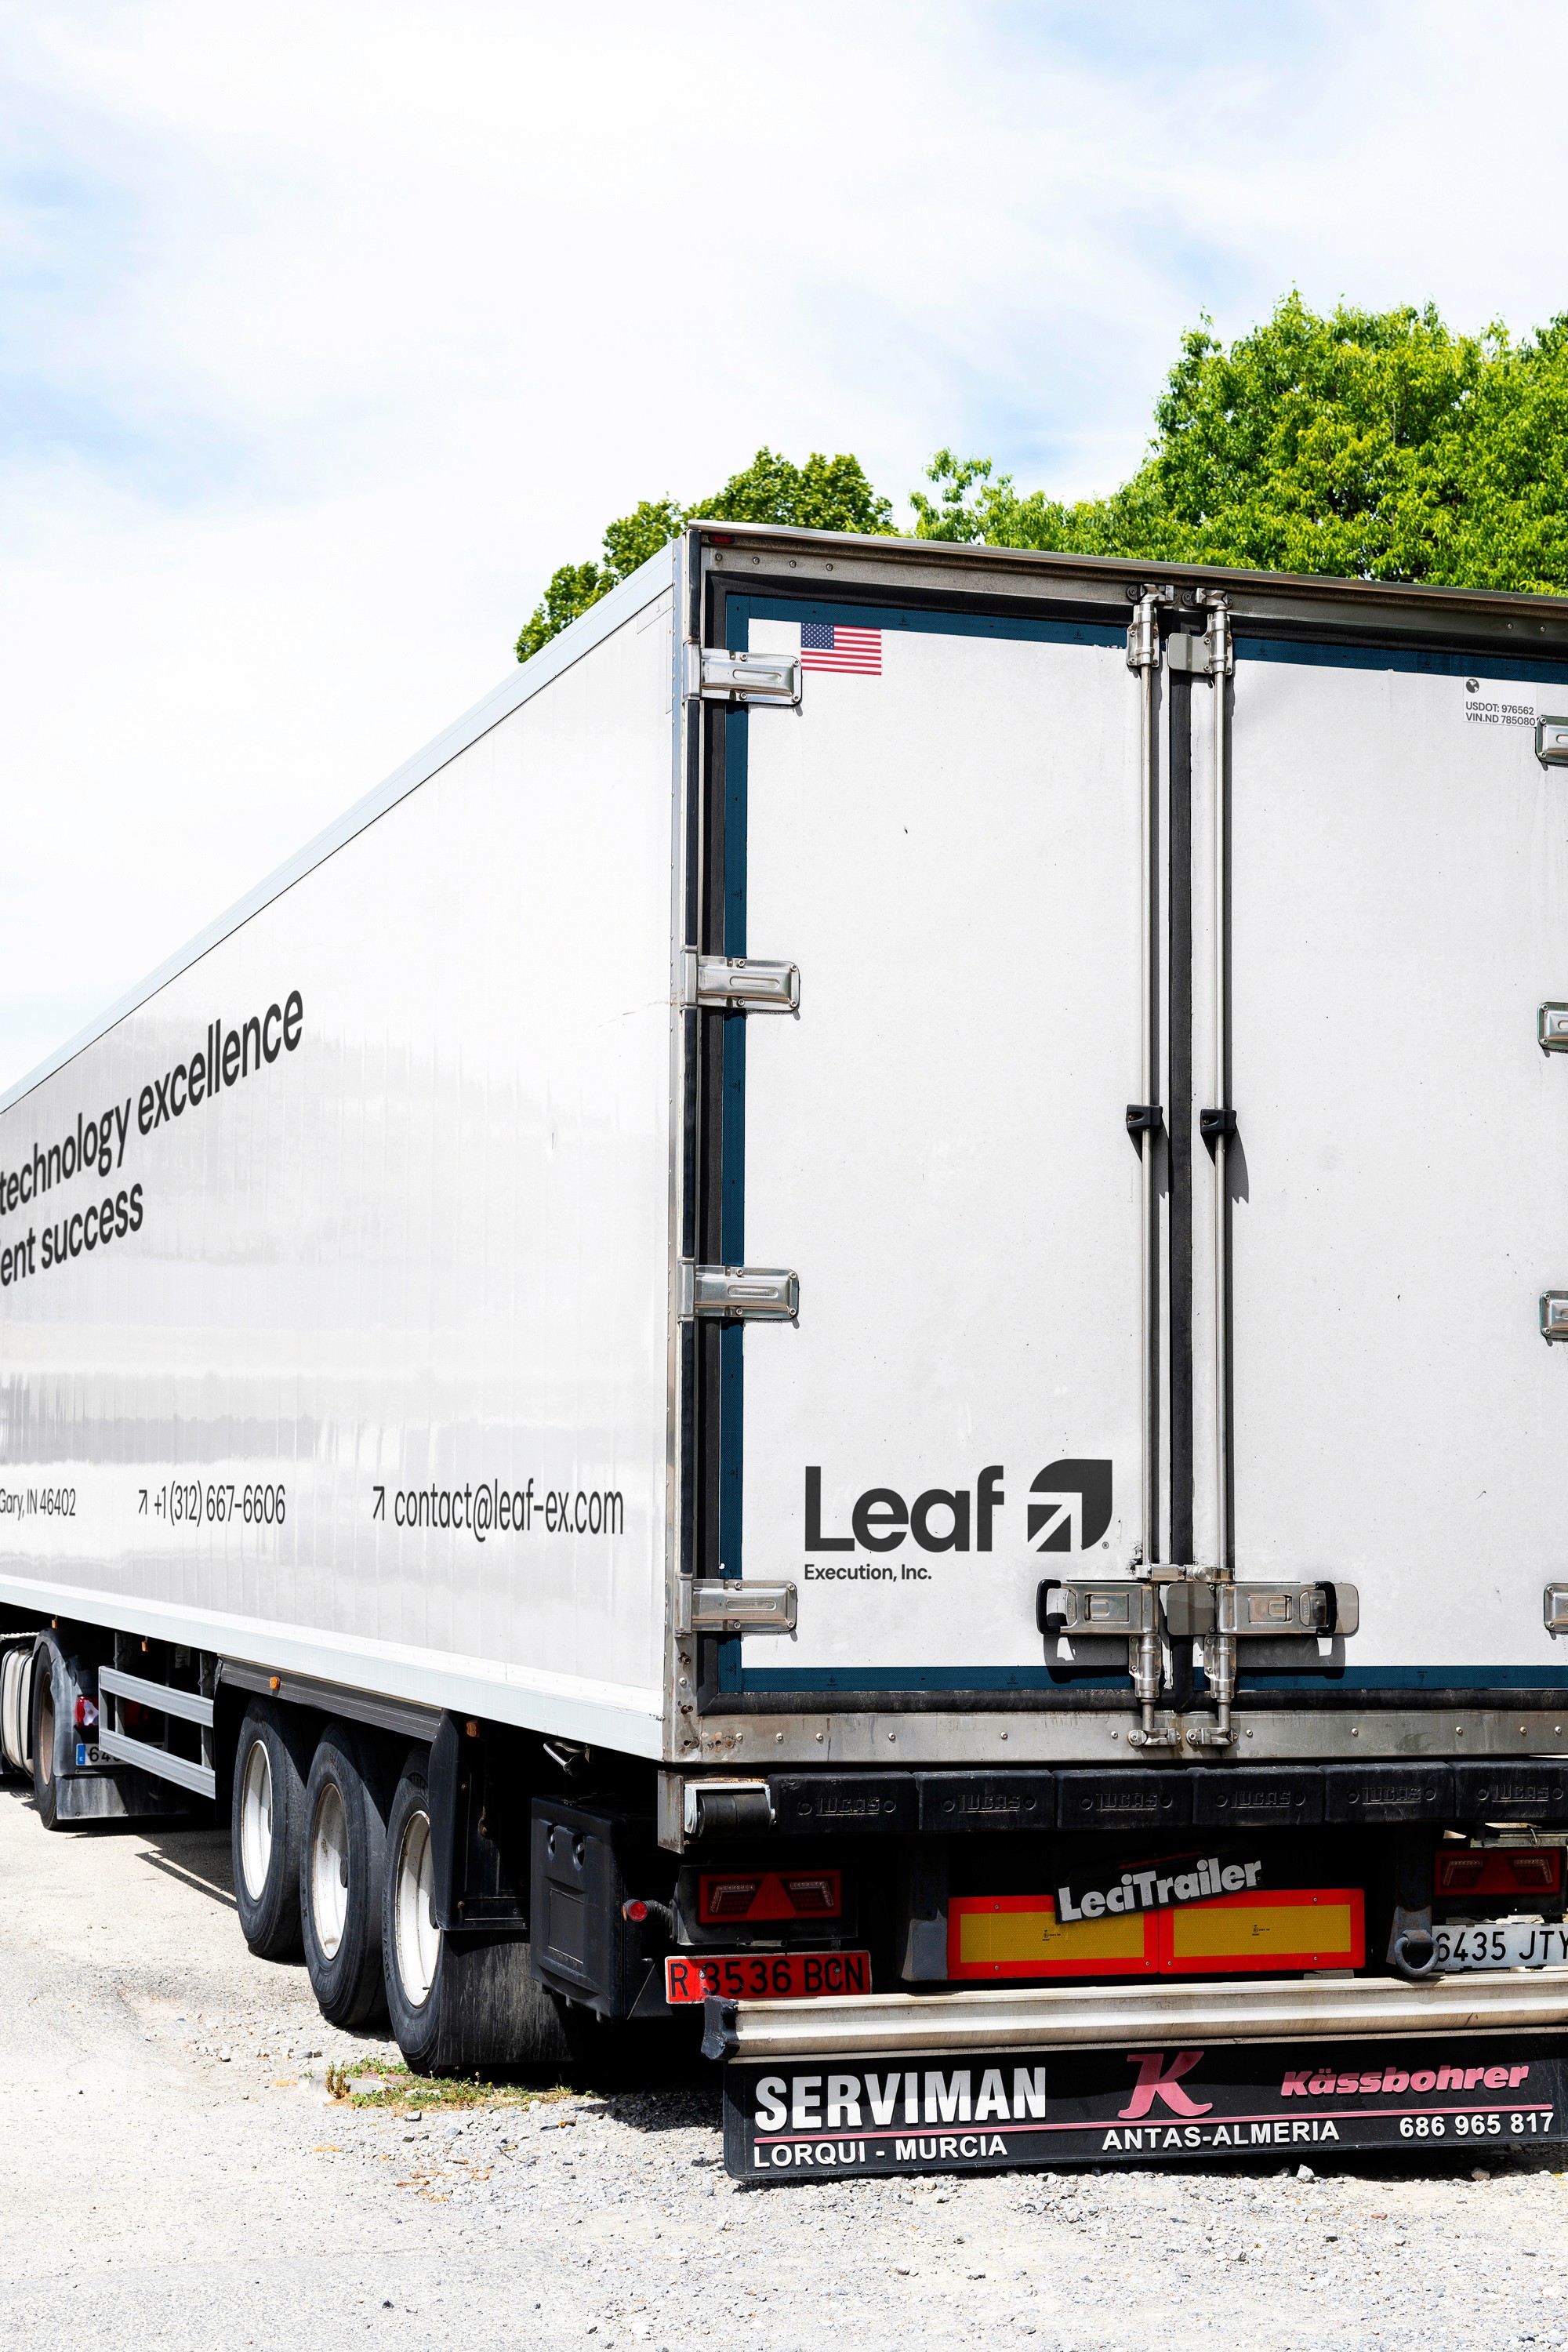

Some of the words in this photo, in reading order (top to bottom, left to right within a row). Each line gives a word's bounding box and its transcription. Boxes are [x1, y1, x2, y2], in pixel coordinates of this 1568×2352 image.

[1466, 702, 1500, 712] USDOT:
[1501, 704, 1534, 715] 976562
[1501, 716, 1536, 726] 785080
[0, 1098, 132, 1215] technology
[137, 990, 303, 1135] excellence
[0, 1227, 36, 1287] ent
[41, 1183, 143, 1269] success
[0, 1488, 24, 1521] Gary,
[27, 1488, 38, 1515] IN
[40, 1488, 76, 1516] 46402
[206, 1484, 286, 1525] 667-6606
[394, 1478, 624, 1543] contact@leaf-ex.com
[804, 1465, 1005, 1553] Leaf
[804, 1563, 898, 1582] Execution,
[901, 1564, 932, 1581] Inc.
[1058, 1857, 1261, 1922] LeciTrailer
[1436, 1931, 1506, 1962] 6435
[1519, 1930, 1568, 1960] JTY
[670, 1962, 689, 1998] R
[704, 1960, 792, 1996] 3536
[804, 1957, 864, 1993] BCN
[1281, 2065, 1529, 2096] Kässbohrer
[755, 2067, 1046, 2132] SERVIMAN
[1102, 2120, 1340, 2150] ANTAS-ALMERIA
[1399, 2116, 1446, 2138] 686
[1454, 2114, 1501, 2136] 965
[1510, 2111, 1554, 2134] 817
[754, 2141, 866, 2169] LORQUI
[895, 2135, 1008, 2161] MURCIA
